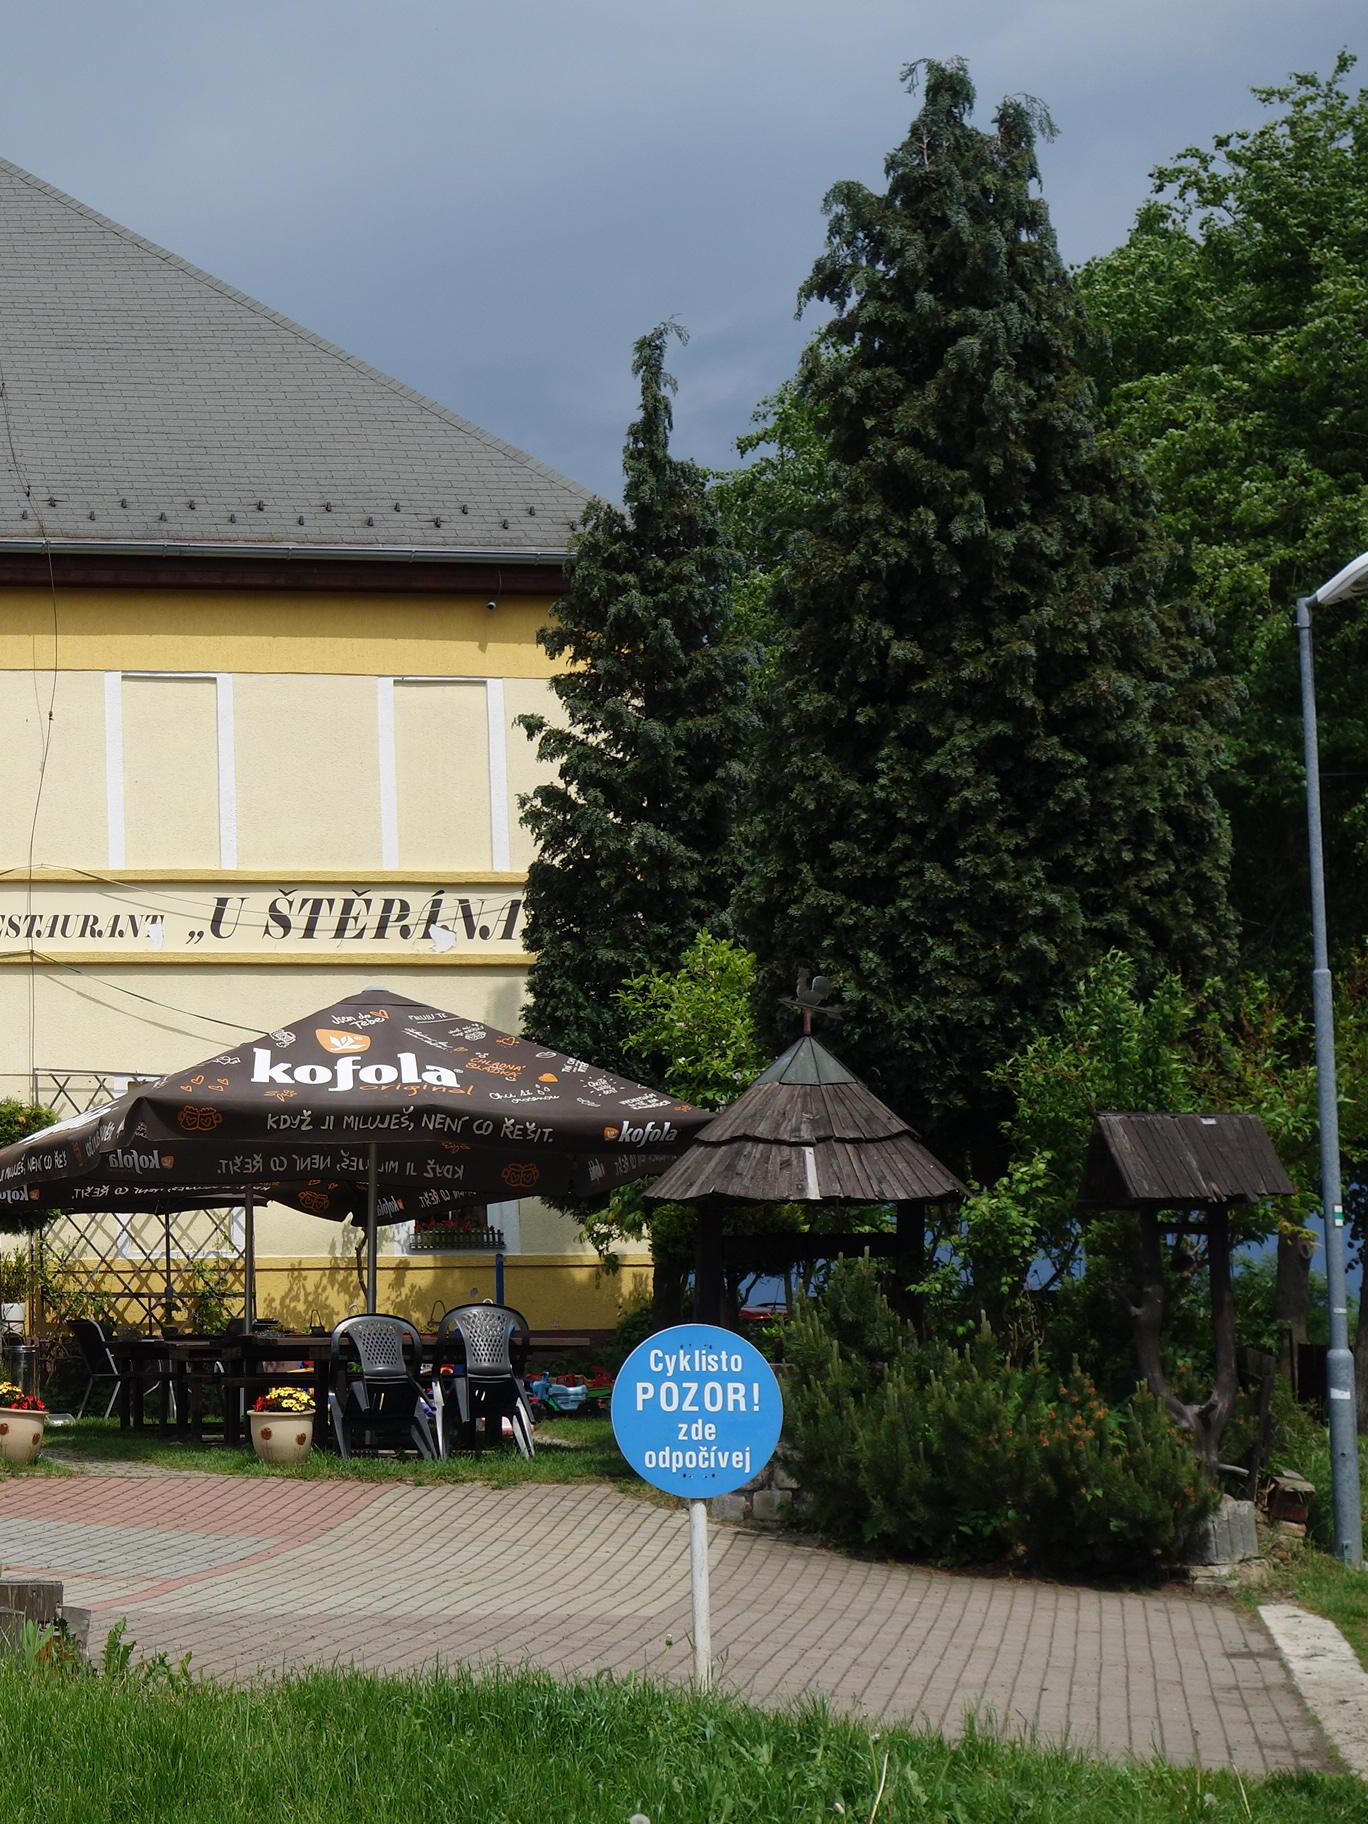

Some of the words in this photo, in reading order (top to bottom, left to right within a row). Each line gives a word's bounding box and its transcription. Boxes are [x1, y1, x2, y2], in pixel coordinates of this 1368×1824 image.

[250, 1047, 461, 1092] kofola
[267, 1109, 313, 1131] KDYŽ
[320, 1115, 334, 1130] JI
[342, 1105, 415, 1131] MILUJEŠ,
[422, 1113, 469, 1134] NENÍ
[472, 1119, 494, 1135] CO
[500, 1117, 554, 1143] ŘEŠIT.
[618, 1121, 678, 1148] kofola
[649, 1349, 743, 1376] Cyklisto
[636, 1381, 760, 1412] POZOR!
[678, 1419, 716, 1442] zde
[644, 1446, 751, 1473] odpočívej
